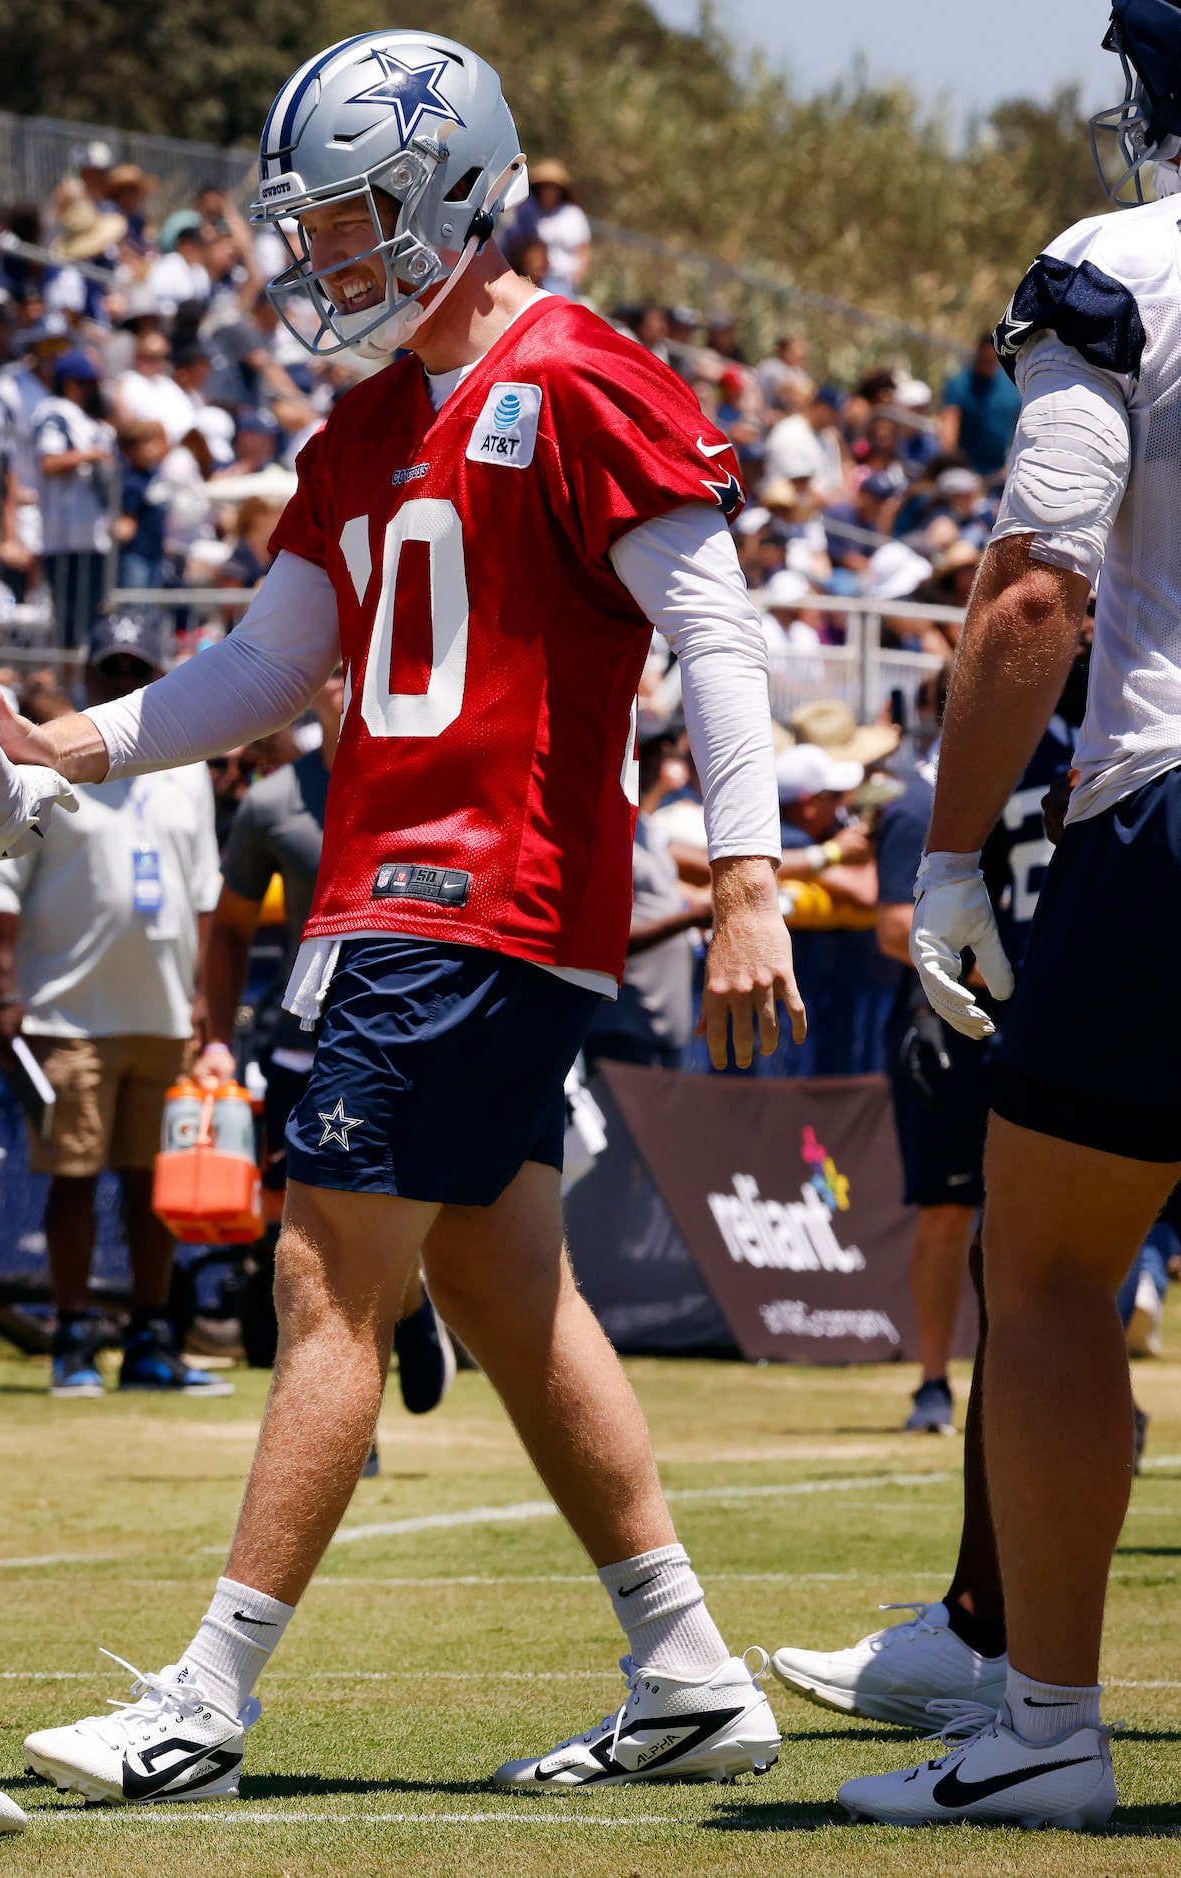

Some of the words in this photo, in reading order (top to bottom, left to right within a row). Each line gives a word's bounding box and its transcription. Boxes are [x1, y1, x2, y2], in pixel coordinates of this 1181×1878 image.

[480, 434, 520, 456] AT&T
[416, 869, 438, 883] 50
[637, 1734, 681, 1767] ALPHA
